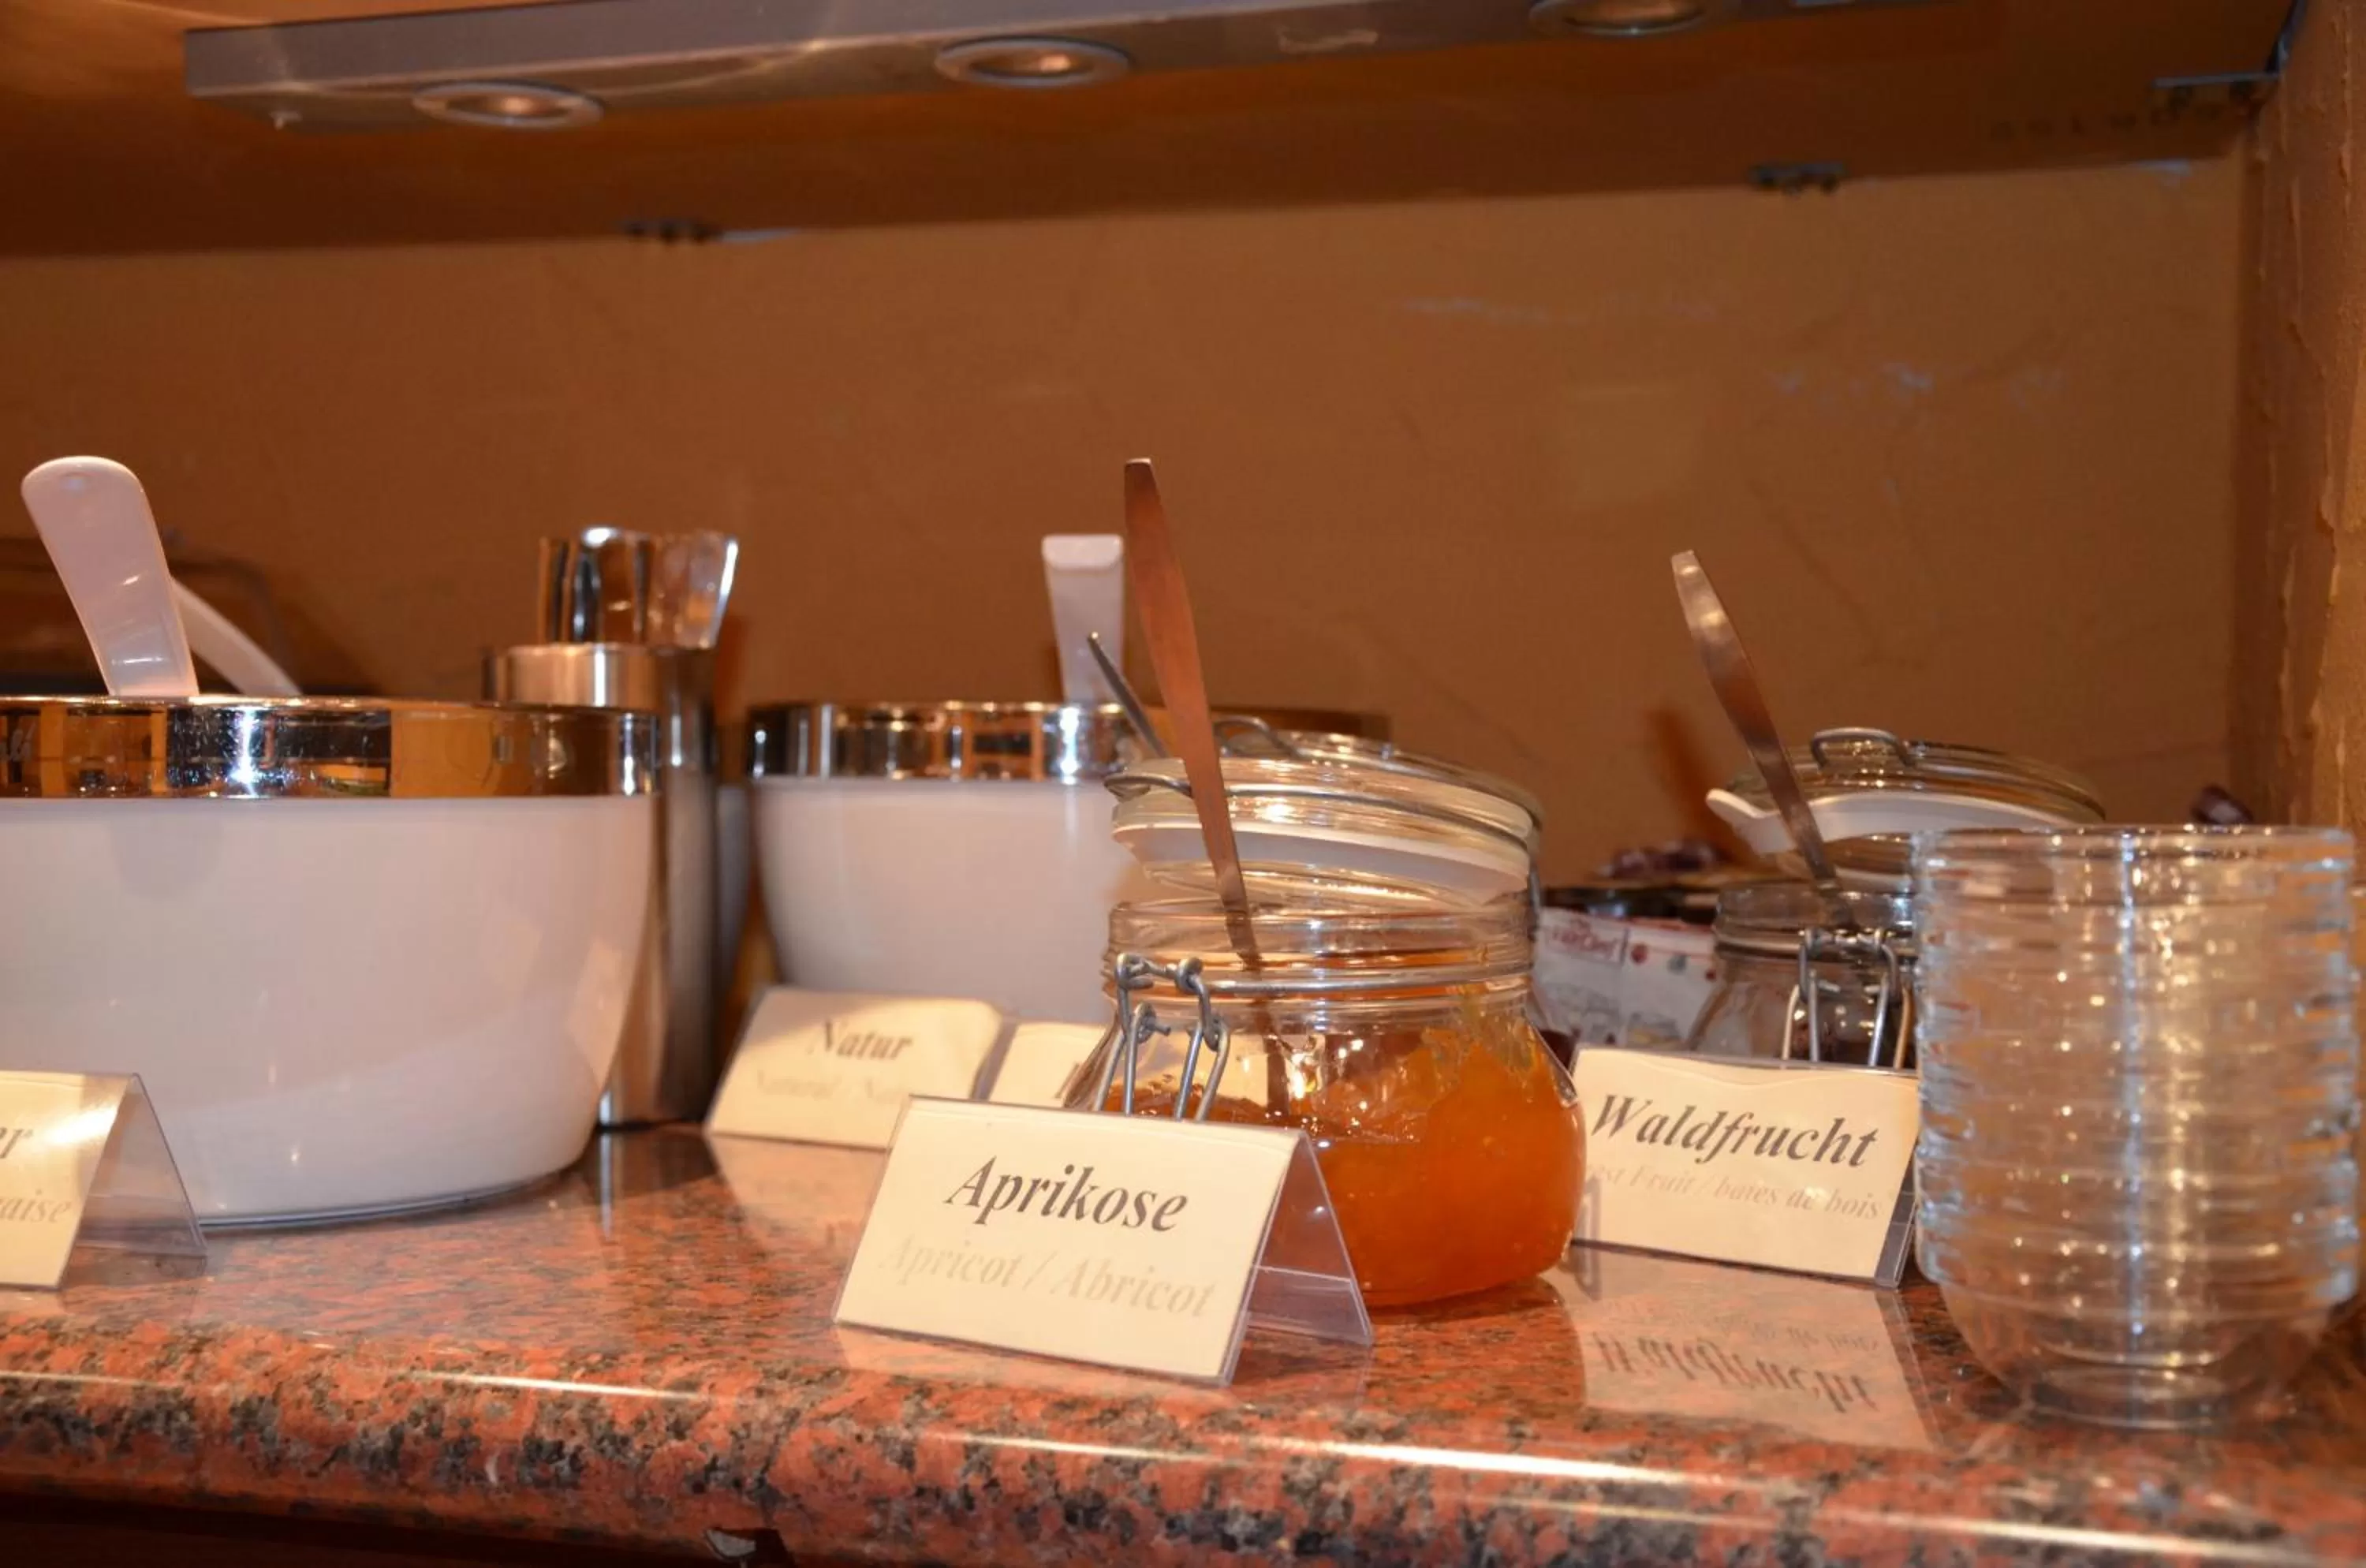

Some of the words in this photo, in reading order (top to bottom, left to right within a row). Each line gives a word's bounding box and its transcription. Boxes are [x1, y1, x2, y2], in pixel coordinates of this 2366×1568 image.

[809, 1020, 913, 1062] Natur
[1590, 1093, 1879, 1168] Waldfrucht
[943, 1155, 1189, 1232] Aprikose
[1629, 1164, 1696, 1193] Fruit
[1714, 1176, 1778, 1206] baies
[1825, 1189, 1881, 1219] bois
[878, 1232, 1024, 1287] Apricot
[1022, 1250, 1058, 1291] /
[1049, 1256, 1216, 1318] Abricot
